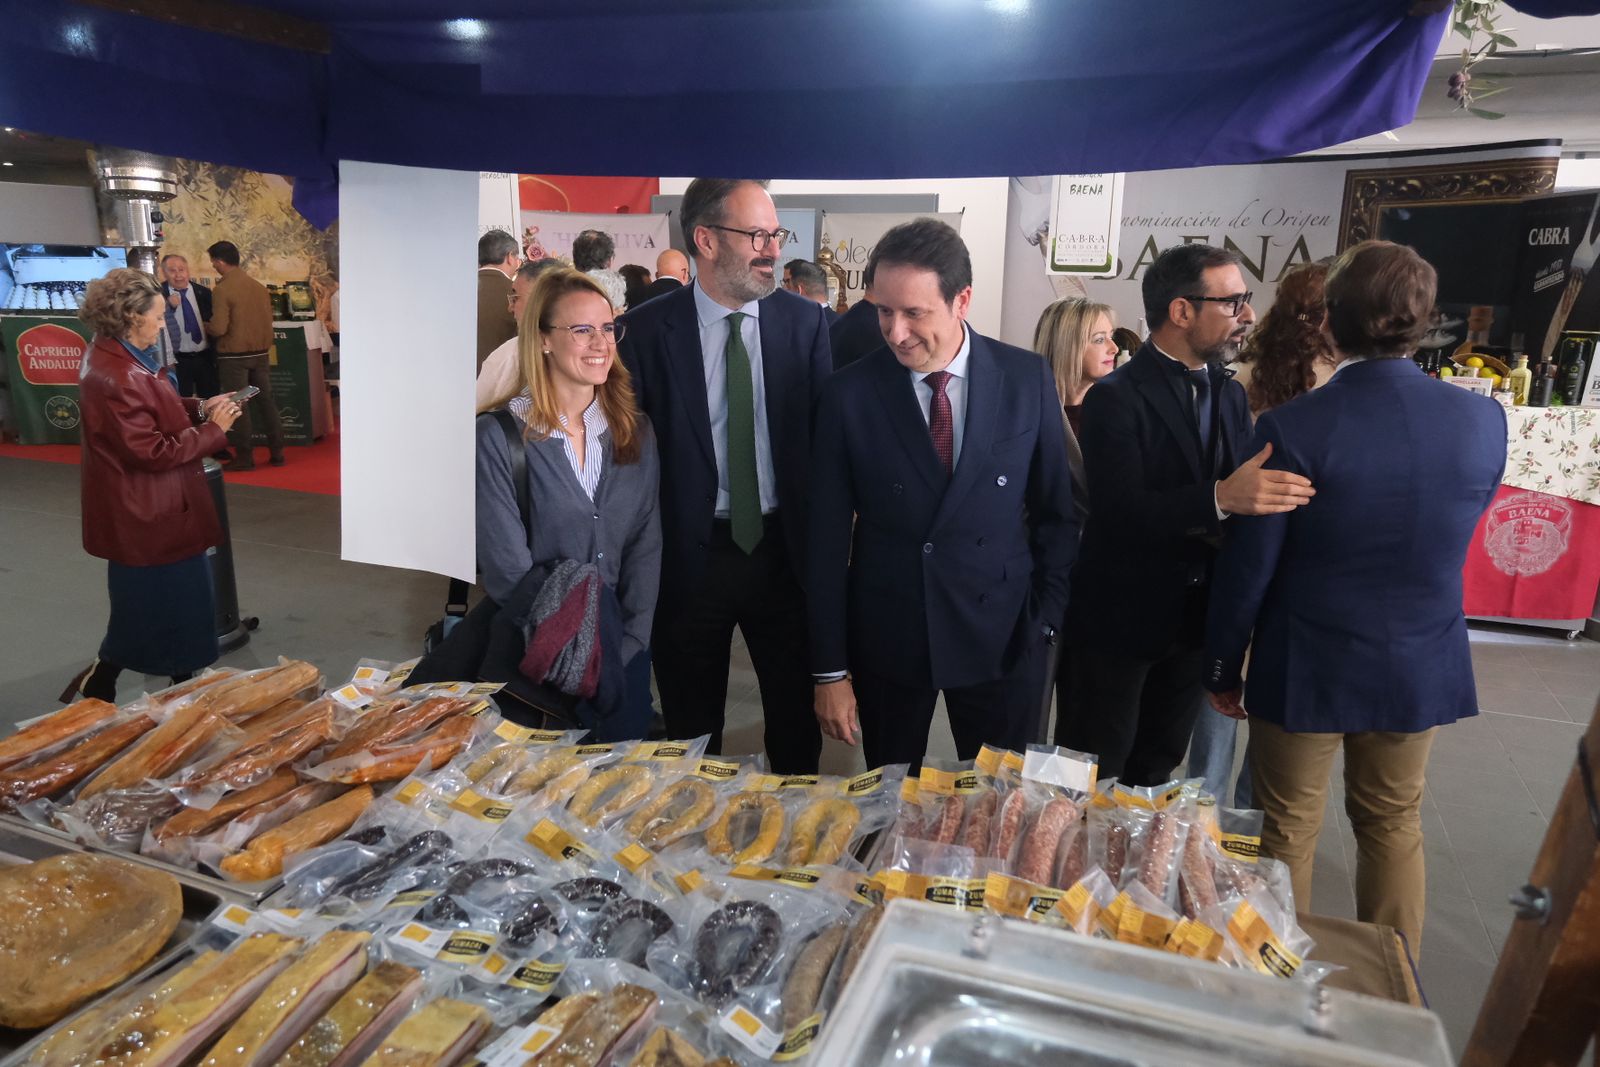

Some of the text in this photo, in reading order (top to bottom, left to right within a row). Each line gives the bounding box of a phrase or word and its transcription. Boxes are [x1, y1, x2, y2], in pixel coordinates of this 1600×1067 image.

[1069, 184, 1103, 195] BAENA
[1121, 211, 1221, 228] nominación
[1261, 208, 1332, 248] Origen
[1528, 227, 1570, 246] CABRA
[24, 343, 81, 357] CAPRICHO
[29, 357, 81, 370] ANDALUZ
[1508, 507, 1550, 519] BAENA
[705, 766, 732, 774] ZUMACAL
[1226, 841, 1259, 852] ZUMACAL
